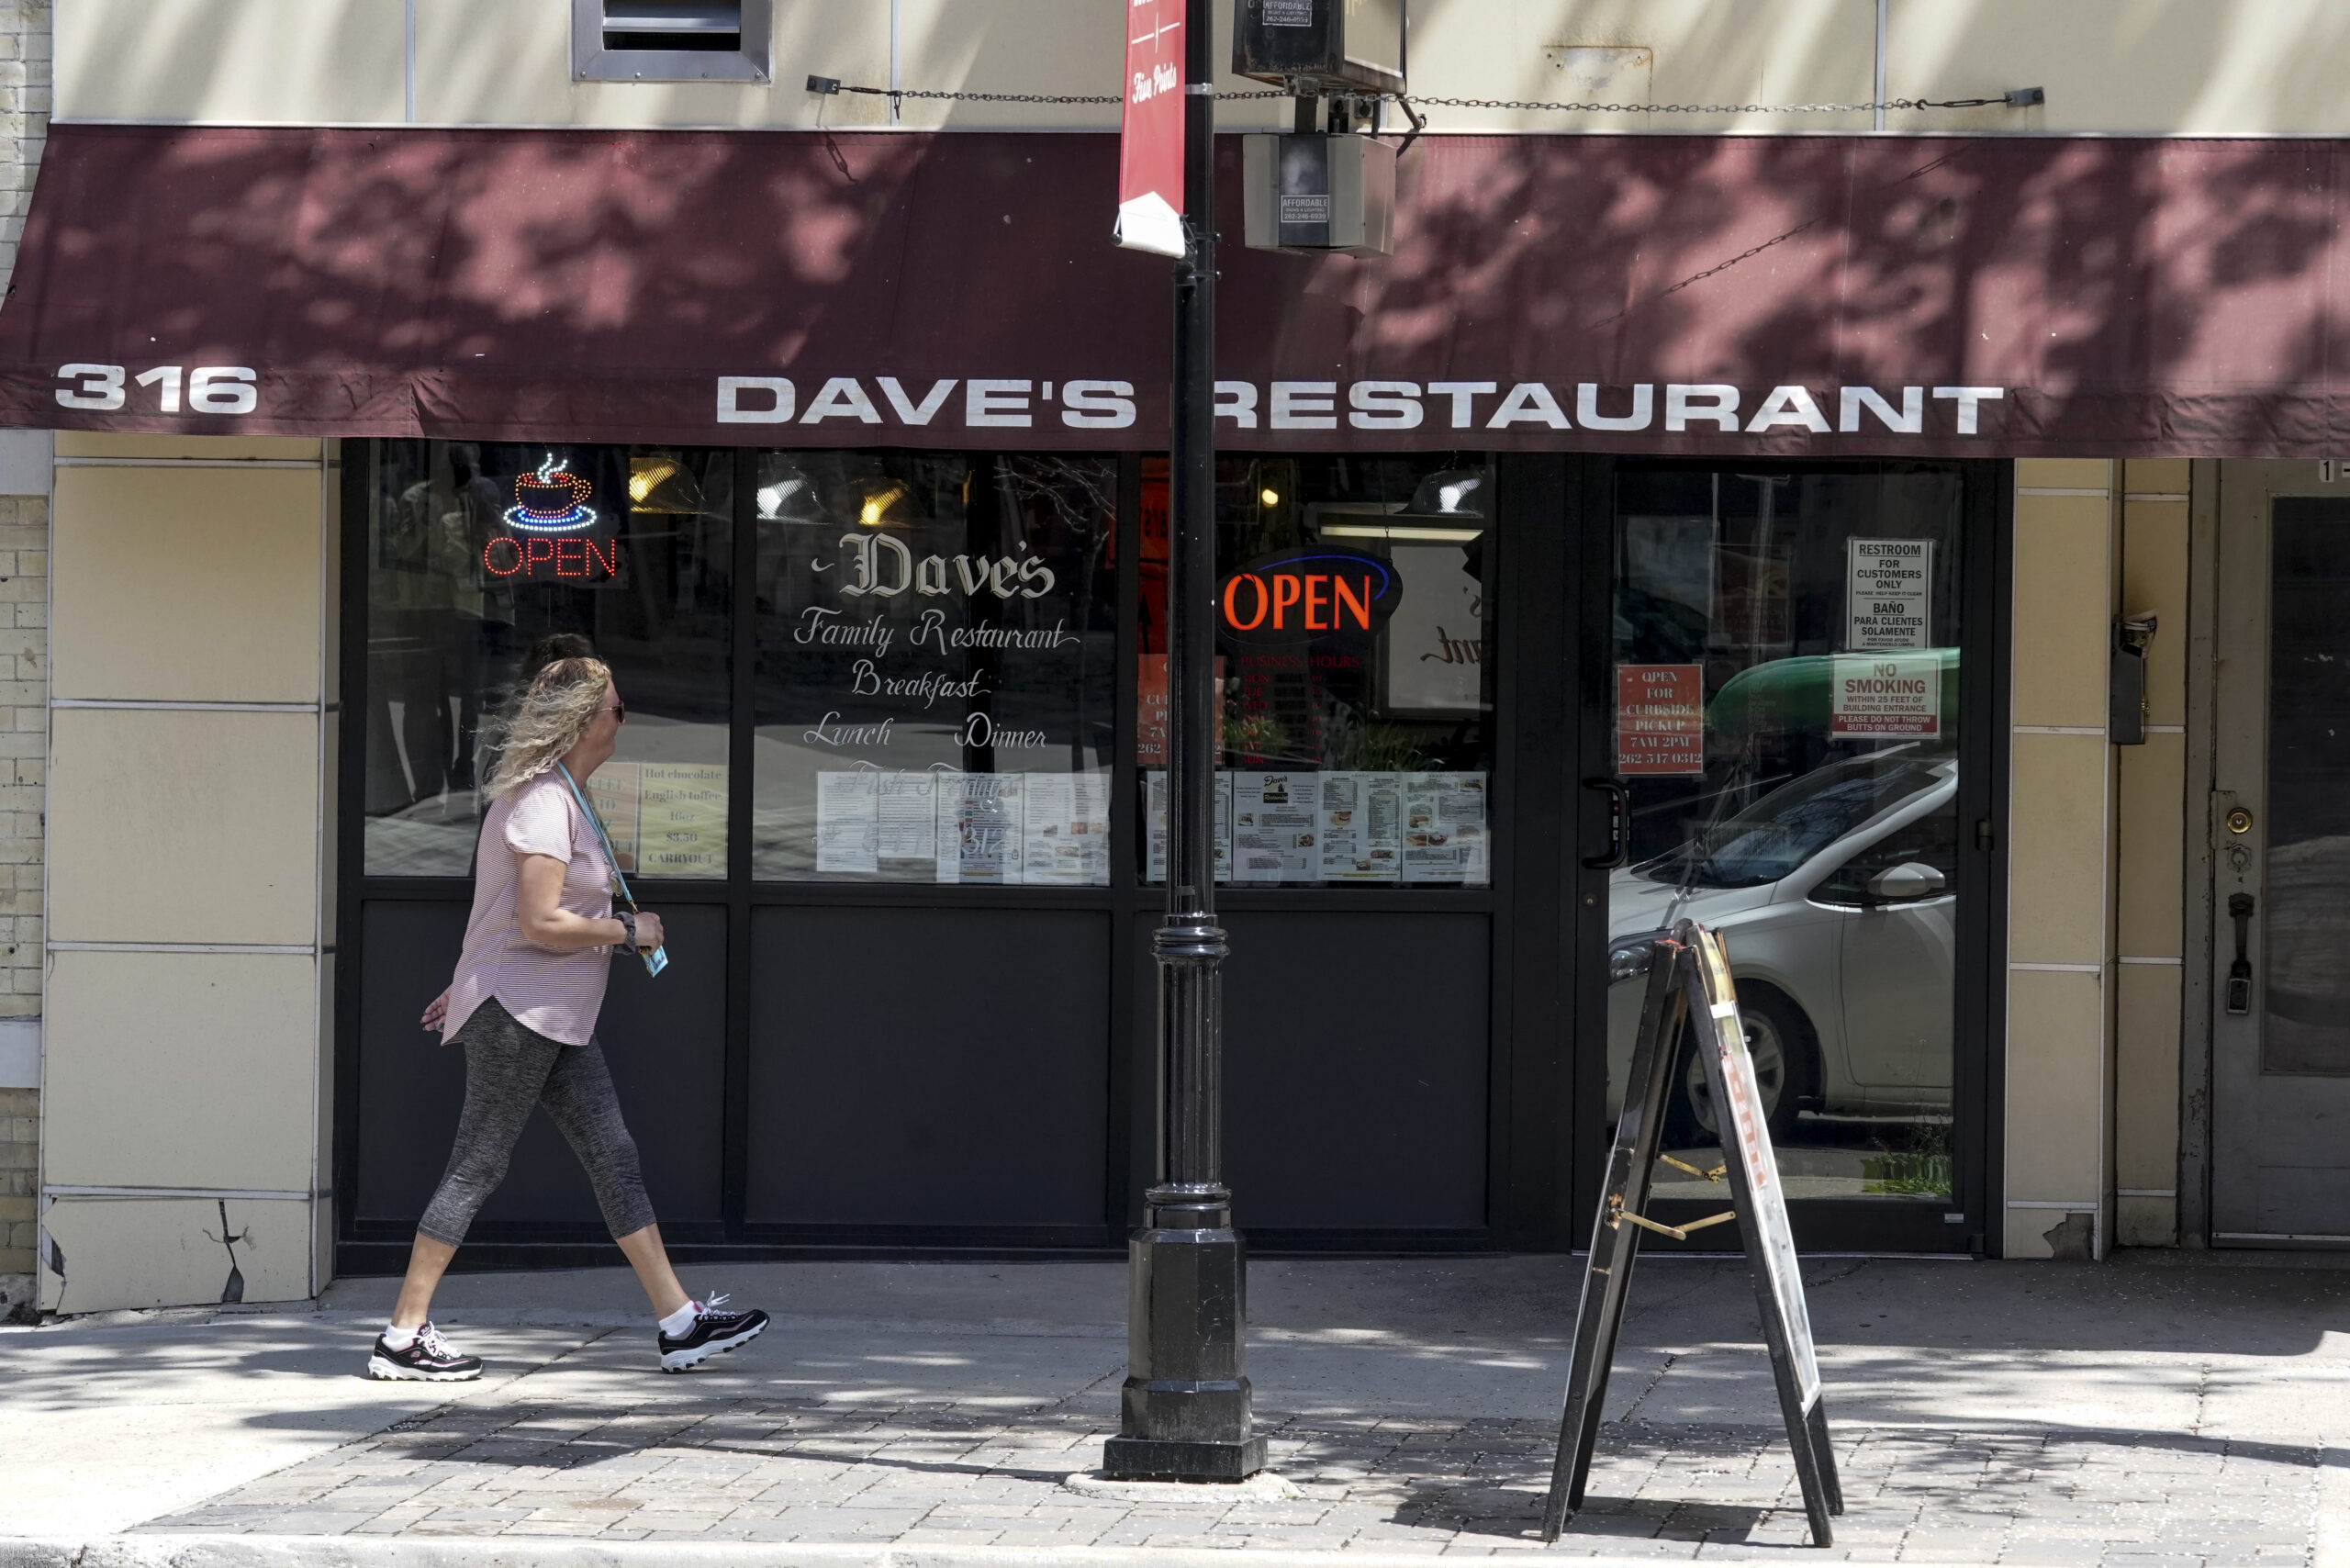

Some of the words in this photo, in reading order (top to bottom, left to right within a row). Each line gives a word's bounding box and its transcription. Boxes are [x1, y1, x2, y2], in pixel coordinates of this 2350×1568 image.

[1153, 62, 1177, 96] Points
[1282, 198, 1328, 207] AFFORDABLE
[55, 363, 257, 414] 316
[717, 376, 1137, 429] DAVE'S
[1170, 381, 2005, 435] RESTAURANT
[1859, 543, 1921, 555] RESTROOM
[485, 537, 616, 577] OPEN
[811, 532, 1055, 599] Dave's
[1879, 559, 1900, 568] FOR
[1857, 569, 1922, 579] CUSTOMERS
[1875, 580, 1902, 589] ONLY
[1224, 572, 1371, 632] OPEN
[1873, 600, 1905, 614] BAÑO
[1854, 616, 1878, 625] PARA
[1881, 617, 1923, 626] CLIENTES
[794, 606, 896, 657] Family
[910, 609, 1080, 655] Restaurant
[1861, 627, 1916, 636] SOLAMENTE
[1240, 654, 1304, 668] BUSINESS
[1309, 655, 1360, 669] HOURS
[1641, 671, 1678, 682] OPEN
[1874, 664, 1897, 677] NO
[852, 659, 991, 710] Breakfast
[1845, 679, 1926, 693] SMOKING
[1646, 688, 1673, 699] FOR
[1847, 695, 1875, 703] WITHIN
[1626, 704, 1694, 715] CURBSIDE
[1839, 715, 1868, 723] PLEASE
[1870, 715, 1882, 723] DO
[803, 711, 894, 746] Lunch
[954, 711, 1047, 748] Dinner
[1150, 726, 1168, 738] 7A
[1636, 720, 1685, 732] PICKUP
[1630, 736, 1658, 747] 7AM
[1662, 736, 1690, 747] 2PM
[1137, 743, 1161, 754] 262
[1619, 753, 1642, 764] 262
[645, 768, 665, 779] Hot
[667, 769, 722, 779] chocolate
[644, 790, 687, 802] English
[688, 790, 722, 801] toffee
[666, 831, 698, 843] $3.50
[648, 853, 714, 864] CARRYOUT
